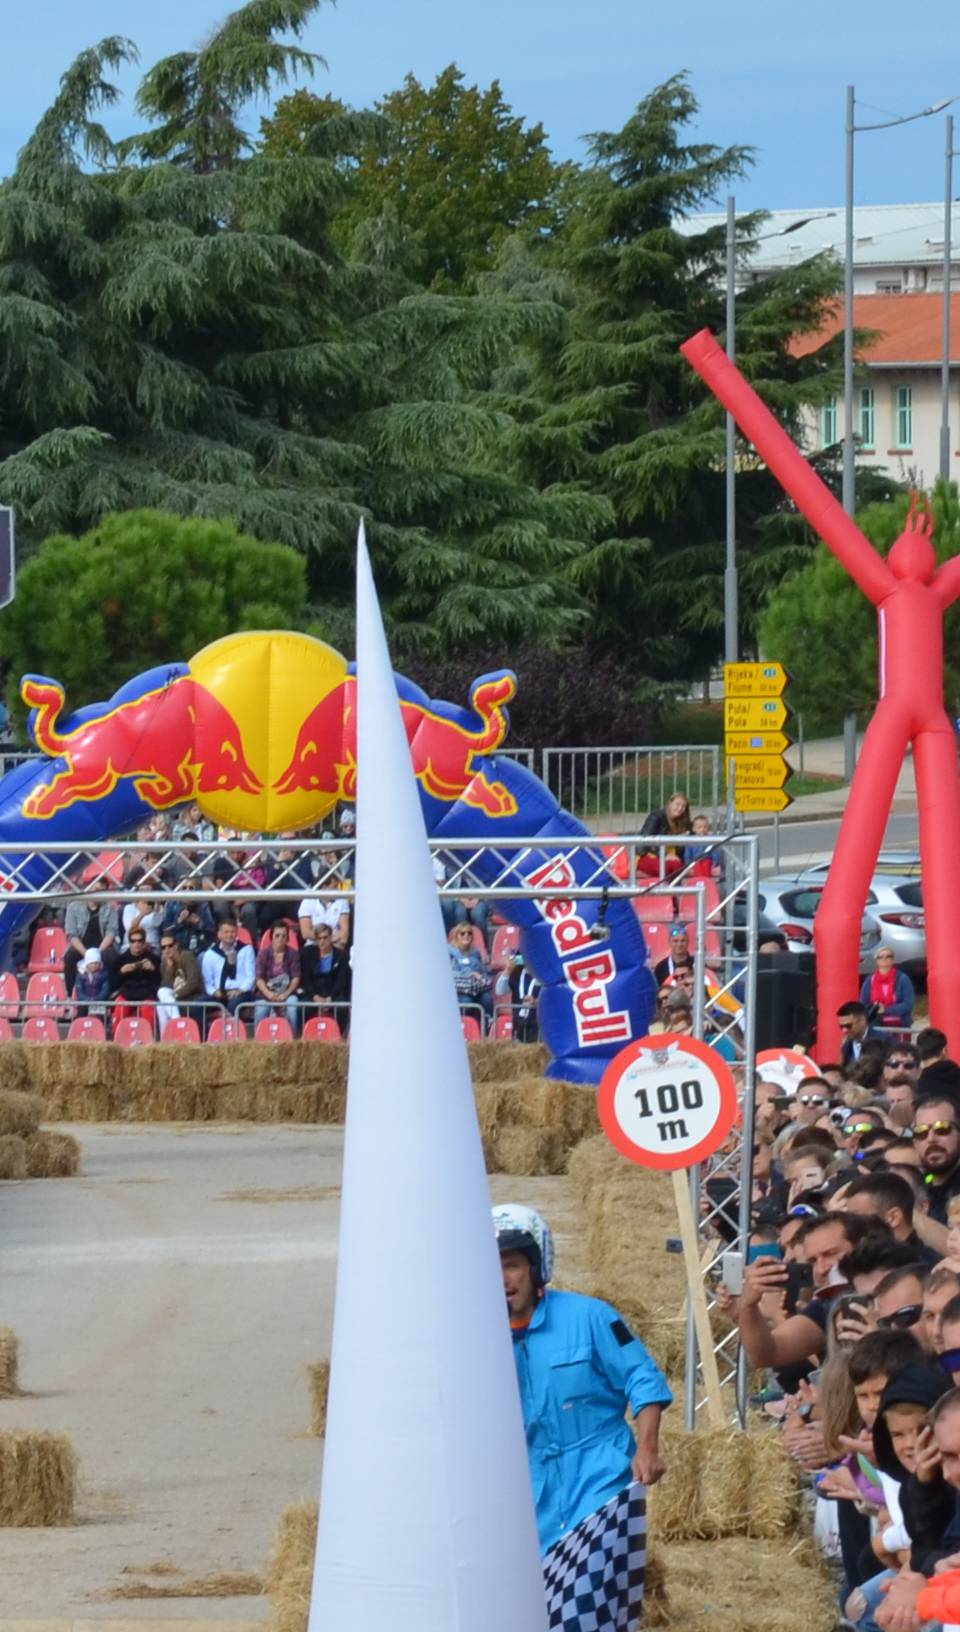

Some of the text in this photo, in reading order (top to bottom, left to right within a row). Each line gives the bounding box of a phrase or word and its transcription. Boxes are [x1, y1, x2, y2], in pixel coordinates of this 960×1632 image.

[522, 854, 631, 1047] Red Bull
[634, 1080, 704, 1118] 100
[657, 1118, 689, 1142] m
